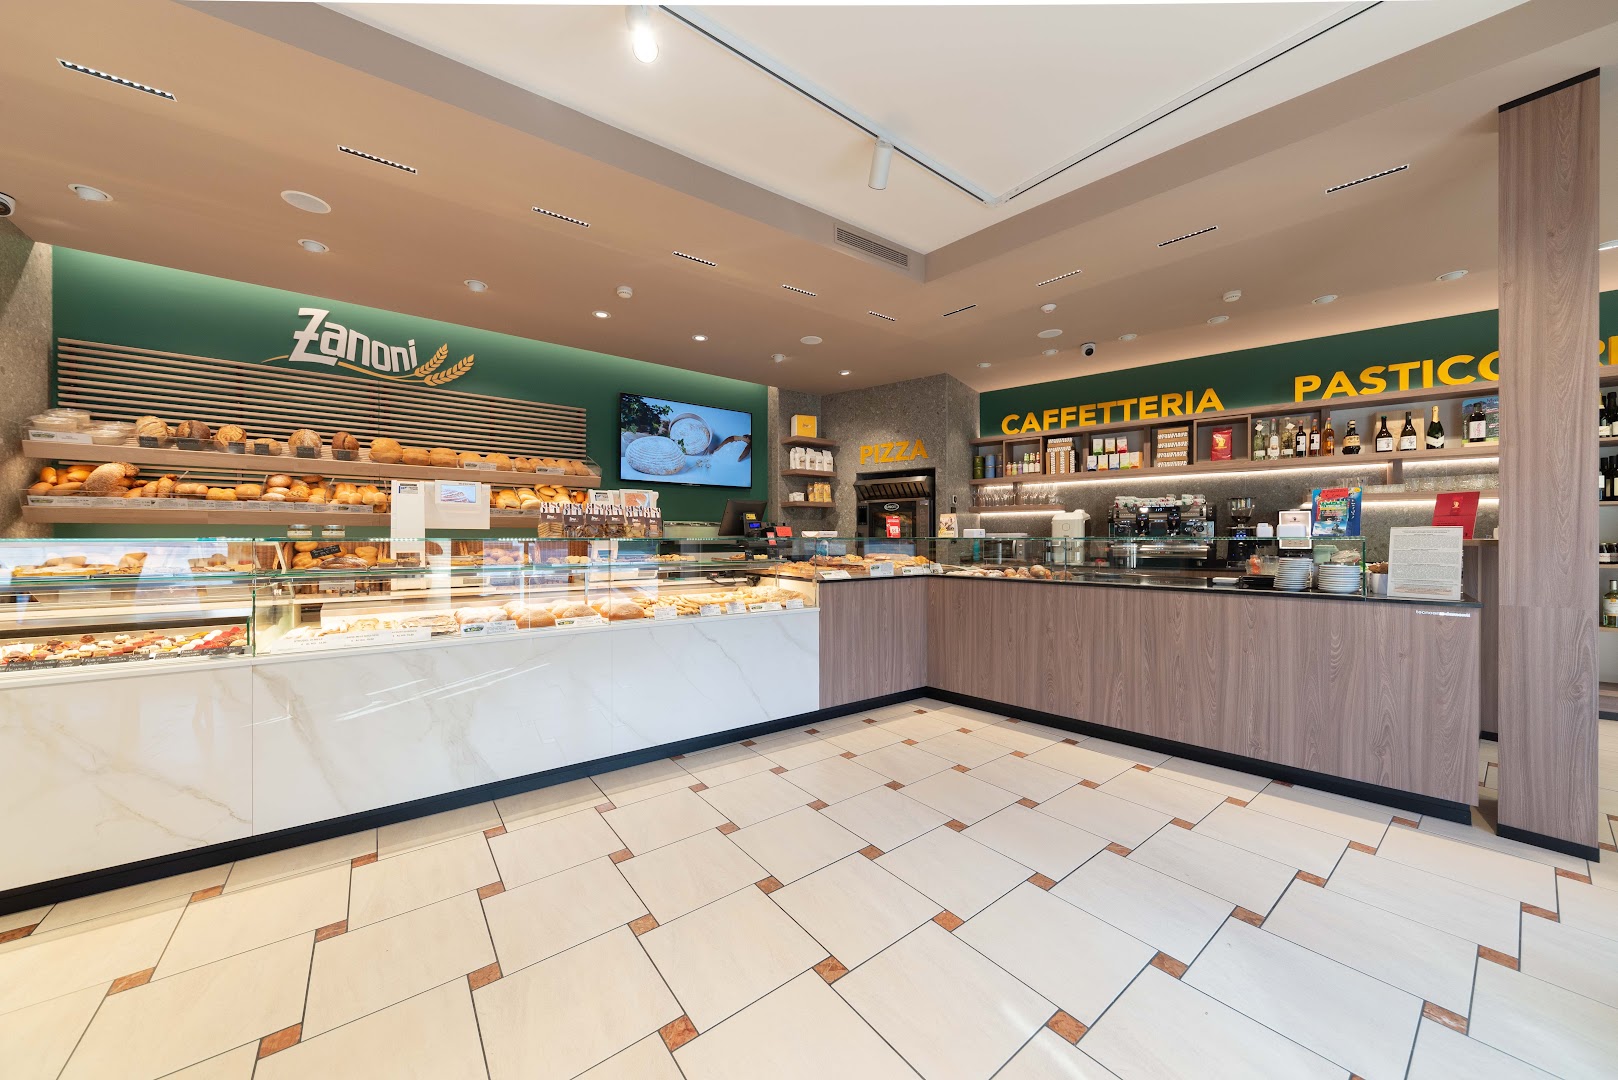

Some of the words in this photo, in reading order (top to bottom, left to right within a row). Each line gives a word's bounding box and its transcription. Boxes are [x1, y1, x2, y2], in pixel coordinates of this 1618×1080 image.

[289, 308, 417, 372] Zanoni
[1001, 388, 1225, 435] CAFFETTERIA
[860, 438, 929, 465] PIZZA
